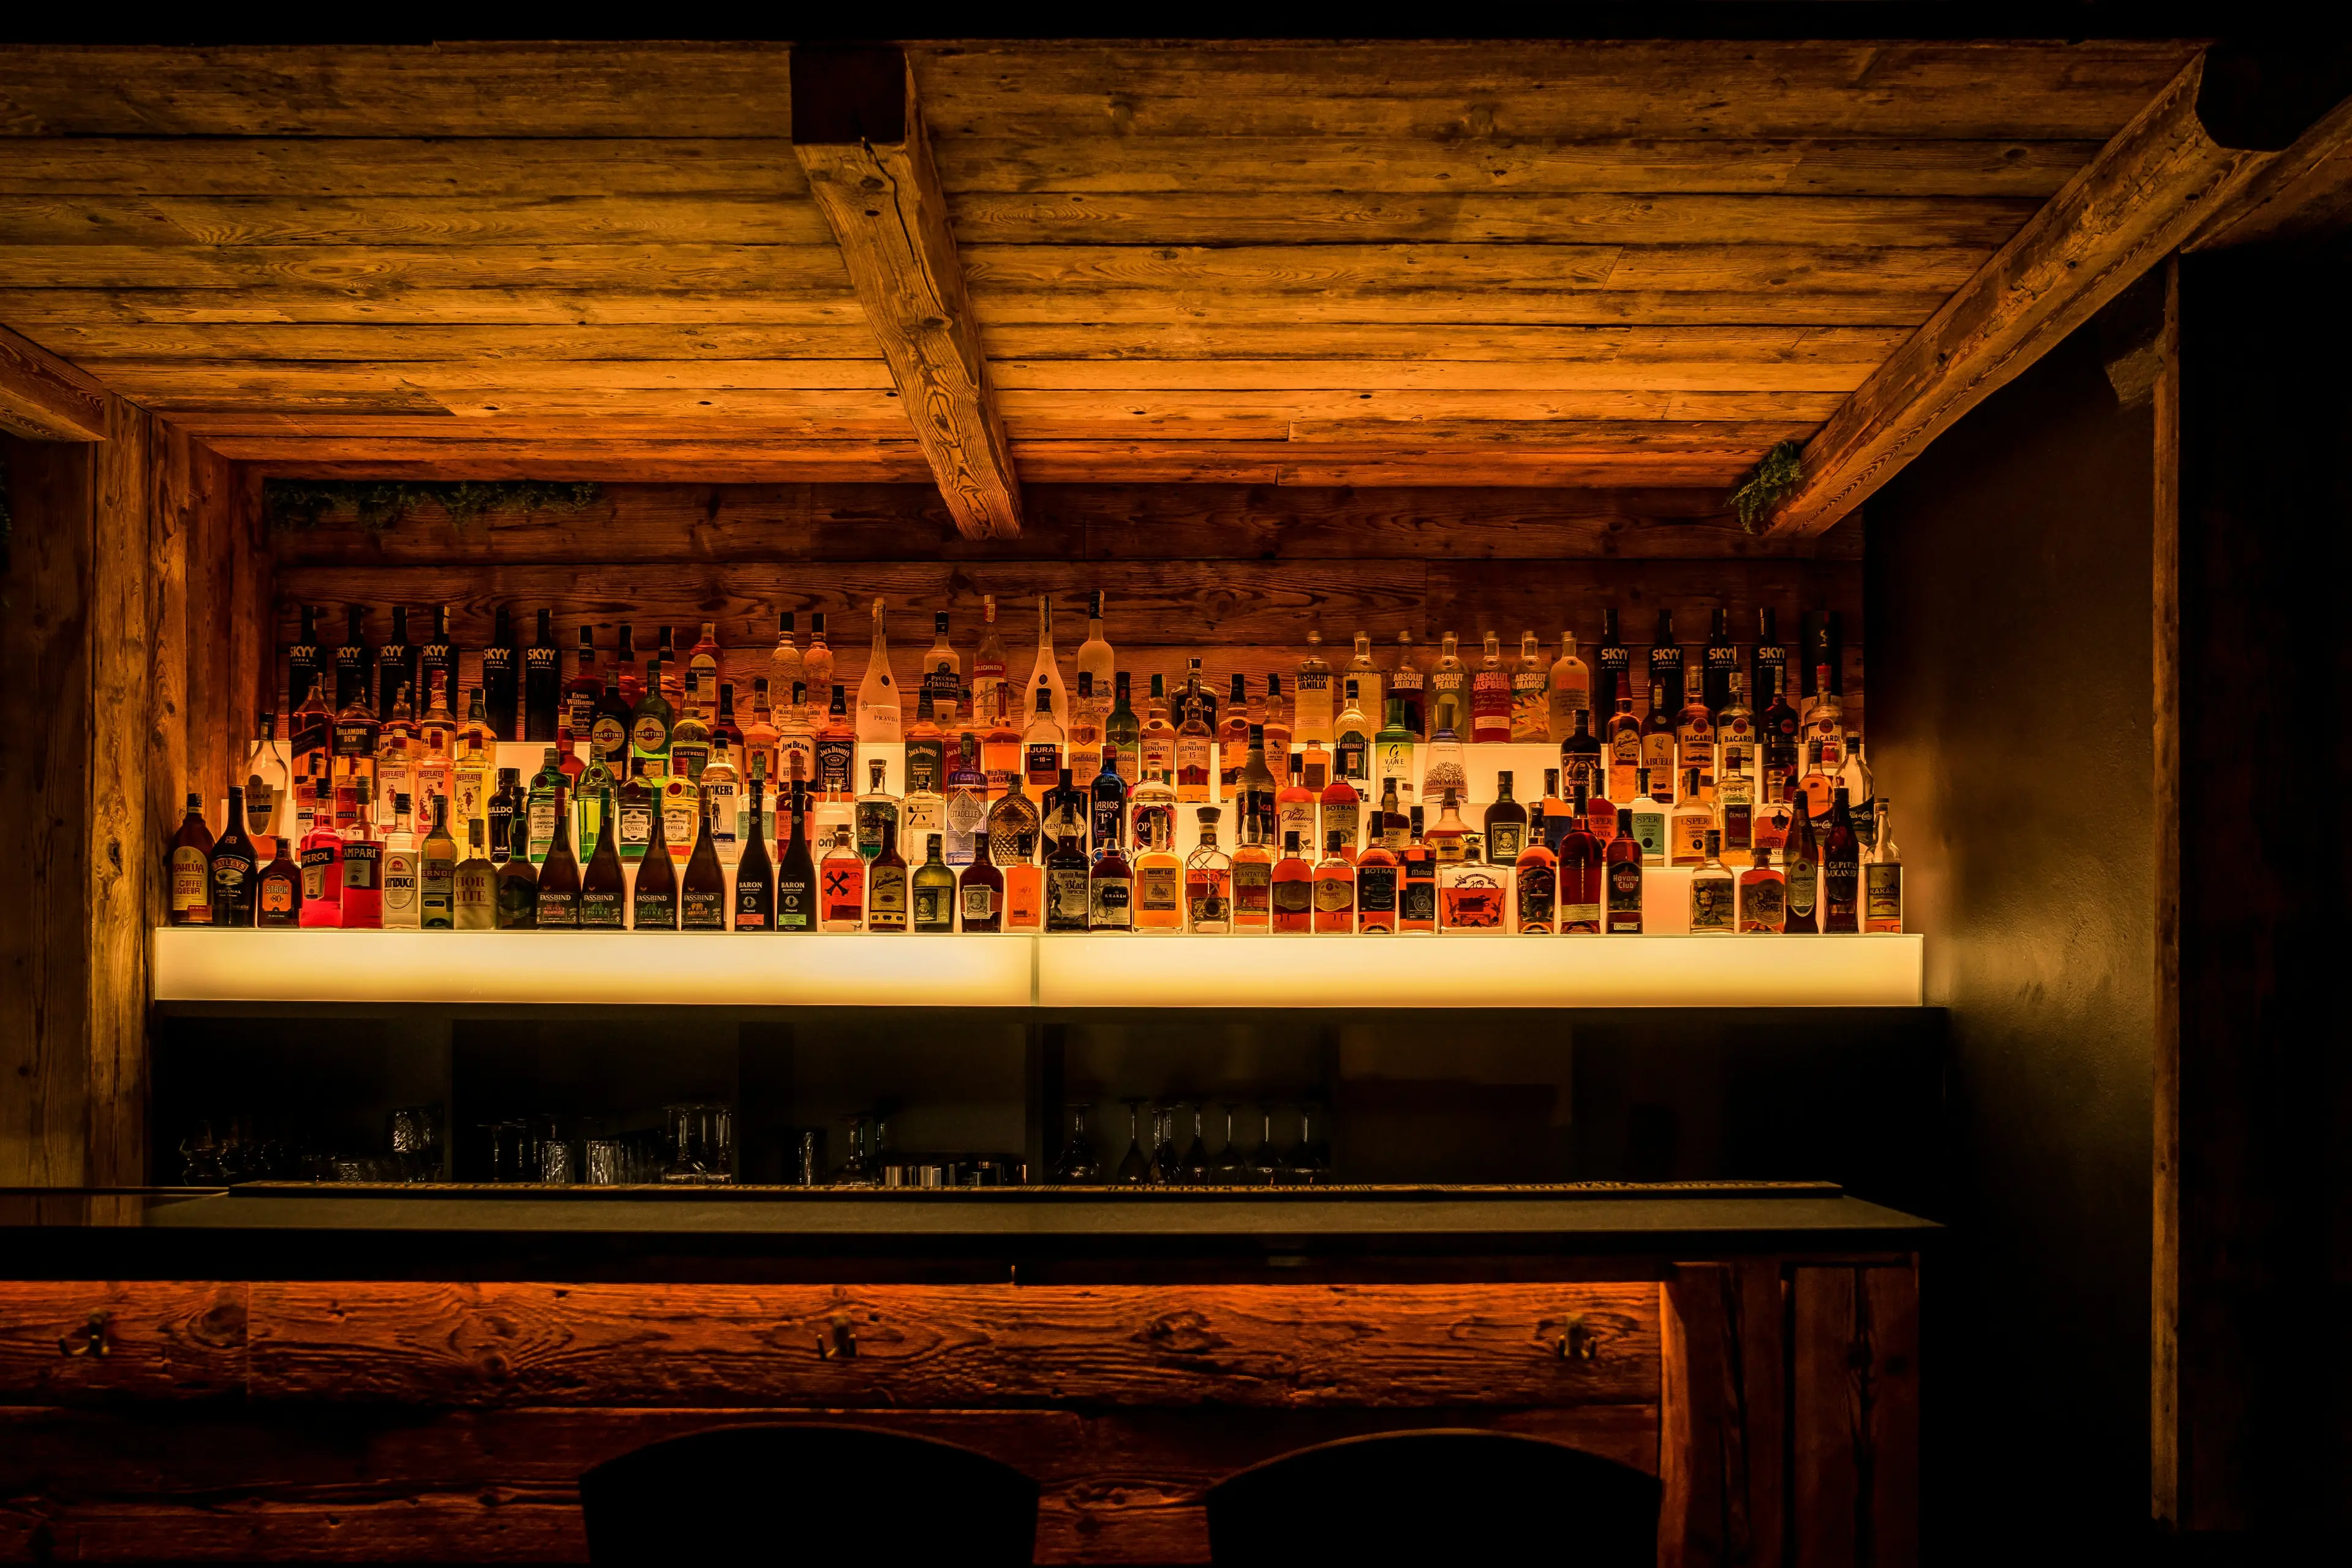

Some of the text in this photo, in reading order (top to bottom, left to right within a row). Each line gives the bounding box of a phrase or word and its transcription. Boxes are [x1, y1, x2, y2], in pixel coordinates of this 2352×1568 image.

[290, 646, 316, 658] SKYY
[337, 647, 361, 658] SKYY
[380, 646, 404, 657] SKYY
[423, 646, 448, 657] SKYY
[484, 649, 510, 660] SKYY
[527, 649, 556, 660] SKYY
[1601, 648, 1629, 660] SKYY
[1652, 649, 1681, 661] SKYY
[1708, 648, 1734, 660] SKYY
[1758, 647, 1785, 659] SKYY
[1433, 674, 1464, 682] ABSOLUT
[1476, 673, 1508, 682] ABSOLUT
[1394, 681, 1423, 690] KURANT
[1436, 681, 1459, 690] PEARS
[1517, 681, 1545, 690] MANGO
[782, 741, 809, 753] JIM BEAM
[820, 746, 850, 757] JACK DANIEL'S
[908, 746, 937, 757] JACK DANIEL'S
[946, 748, 958, 758] JACK
[1072, 754, 1098, 763] Glenfiddich
[1645, 757, 1673, 766] ABUELO
[456, 774, 482, 782] BEEFEATER
[1095, 801, 1120, 811] LARIOS
[951, 810, 978, 818] CITADELLE
[214, 860, 245, 870] BAILEYS
[456, 876, 484, 887] FIOR
[456, 891, 486, 902] VITE
